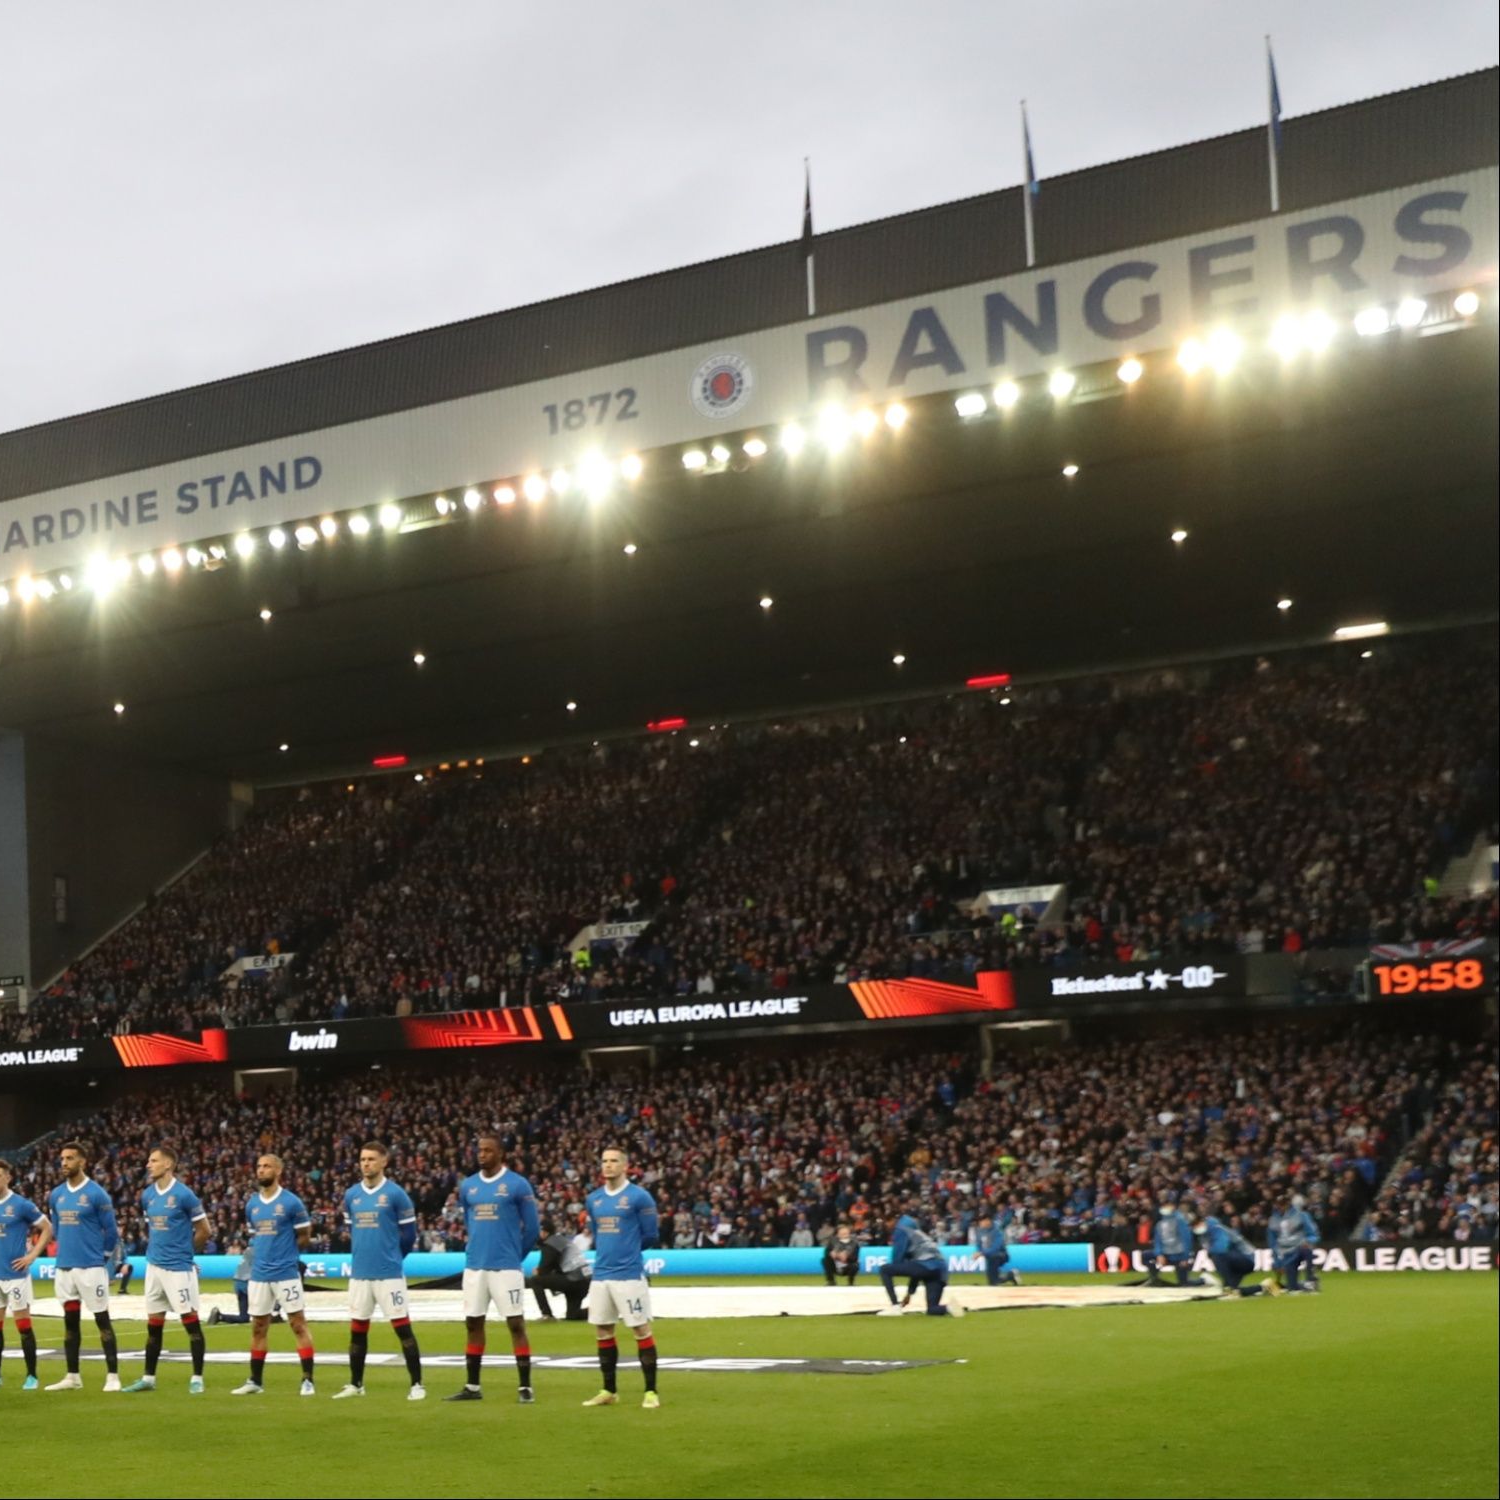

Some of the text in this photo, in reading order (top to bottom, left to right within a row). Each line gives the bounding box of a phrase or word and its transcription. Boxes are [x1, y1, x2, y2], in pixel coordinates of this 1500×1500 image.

[805, 190, 1474, 400] RANGERS
[542, 388, 640, 434] 1872
[176, 455, 324, 514] STAND
[1051, 972, 1145, 996] Heineken
[1374, 960, 1484, 995] 19:58
[610, 1010, 655, 1026] UEFA
[658, 1004, 726, 1023] EUROPA
[289, 1031, 338, 1050] bwin
[1356, 1246, 1492, 1271] LEAGUE
[13, 1288, 21, 1301] 8
[96, 1285, 105, 1298] 6
[178, 1288, 190, 1304] 31
[283, 1286, 300, 1302] 25
[390, 1291, 404, 1307] 16
[508, 1289, 521, 1305] 17
[626, 1298, 642, 1314] 14
